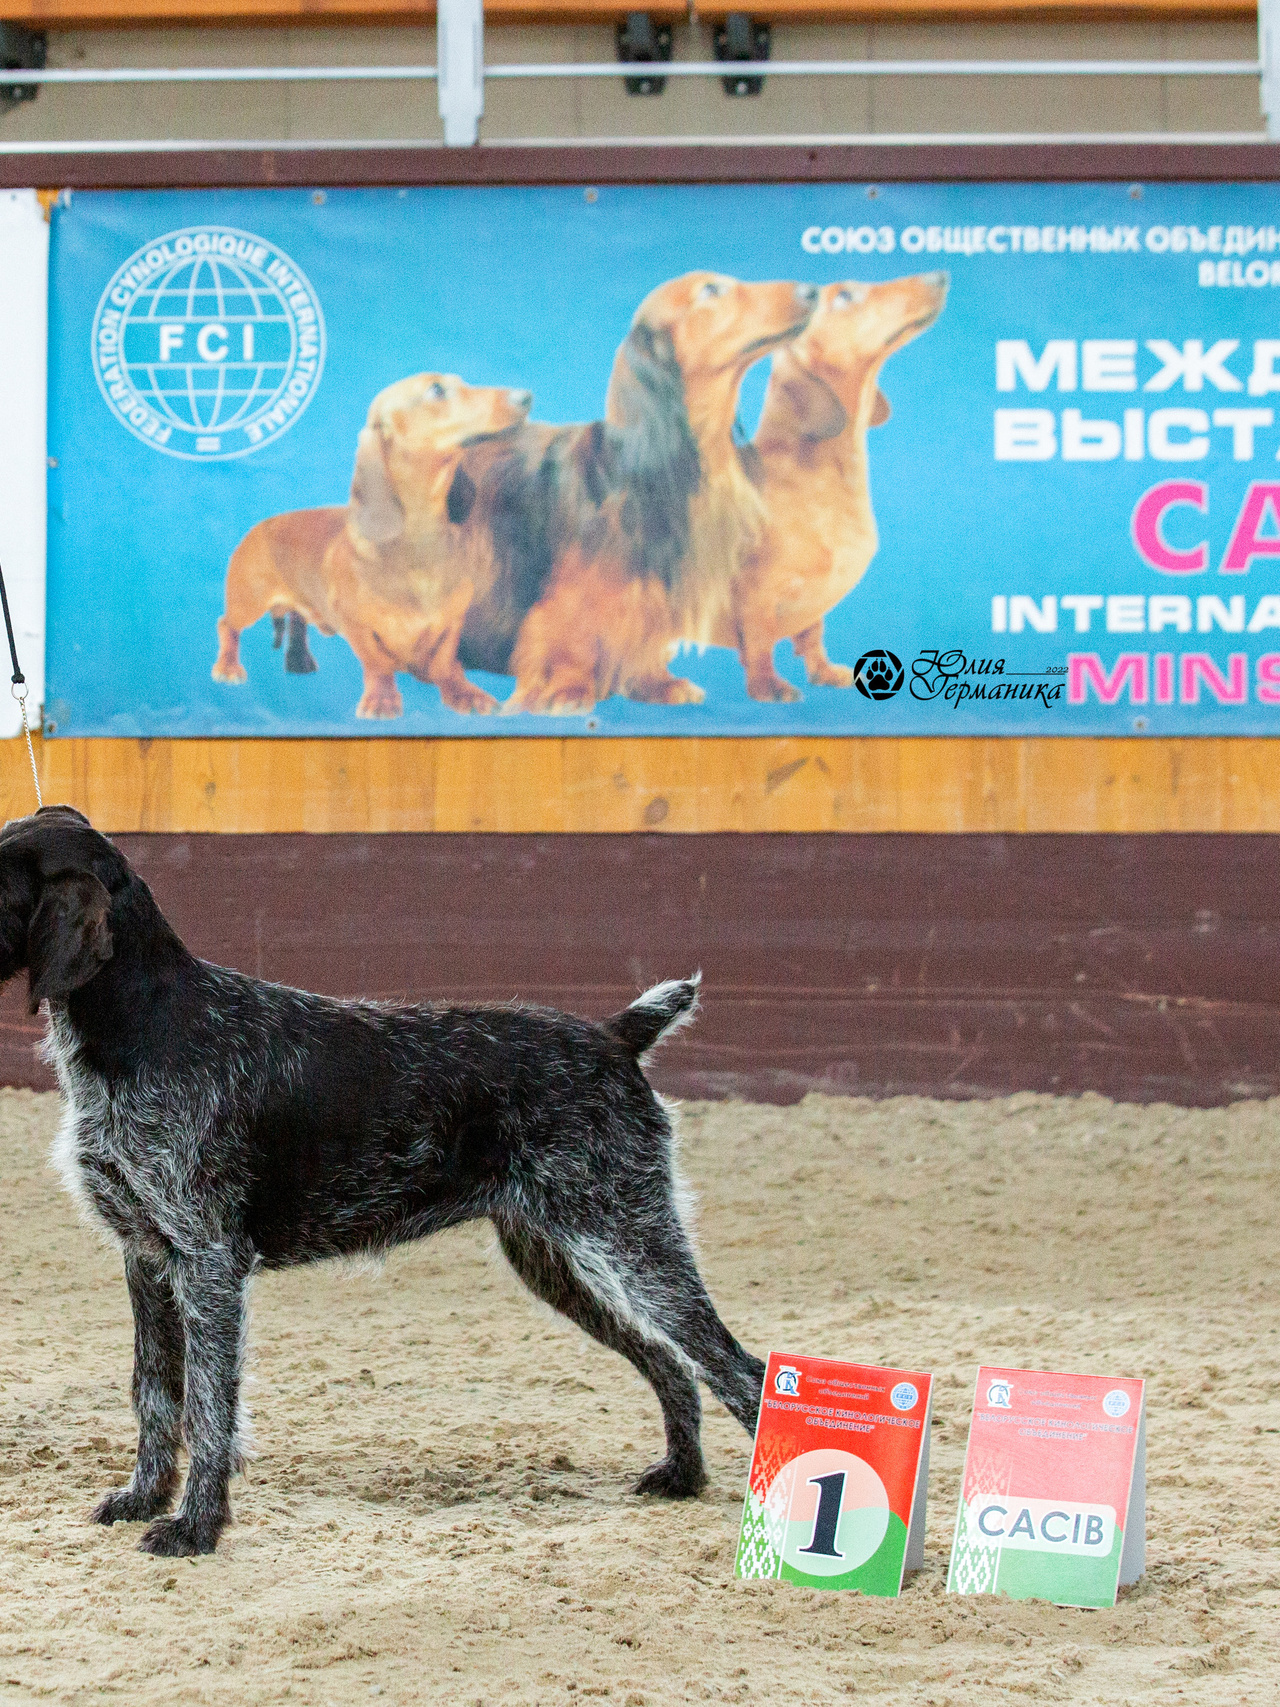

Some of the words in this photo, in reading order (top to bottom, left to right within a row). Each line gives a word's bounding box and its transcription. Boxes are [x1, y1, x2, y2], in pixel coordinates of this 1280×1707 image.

[801, 226, 896, 254] СОЮЗ
[900, 226, 1141, 257] ОБЩЕСТВЕННЫХ
[110, 233, 269, 306] CYNOLOGIQUE
[244, 259, 318, 445] INTERNATIONALE
[159, 324, 254, 361] FCI
[993, 408, 1280, 461] ВЫСТ
[991, 595, 1280, 633] INTERNA
[798, 1471, 848, 1559] 1
[977, 1505, 1105, 1546] CACIB
